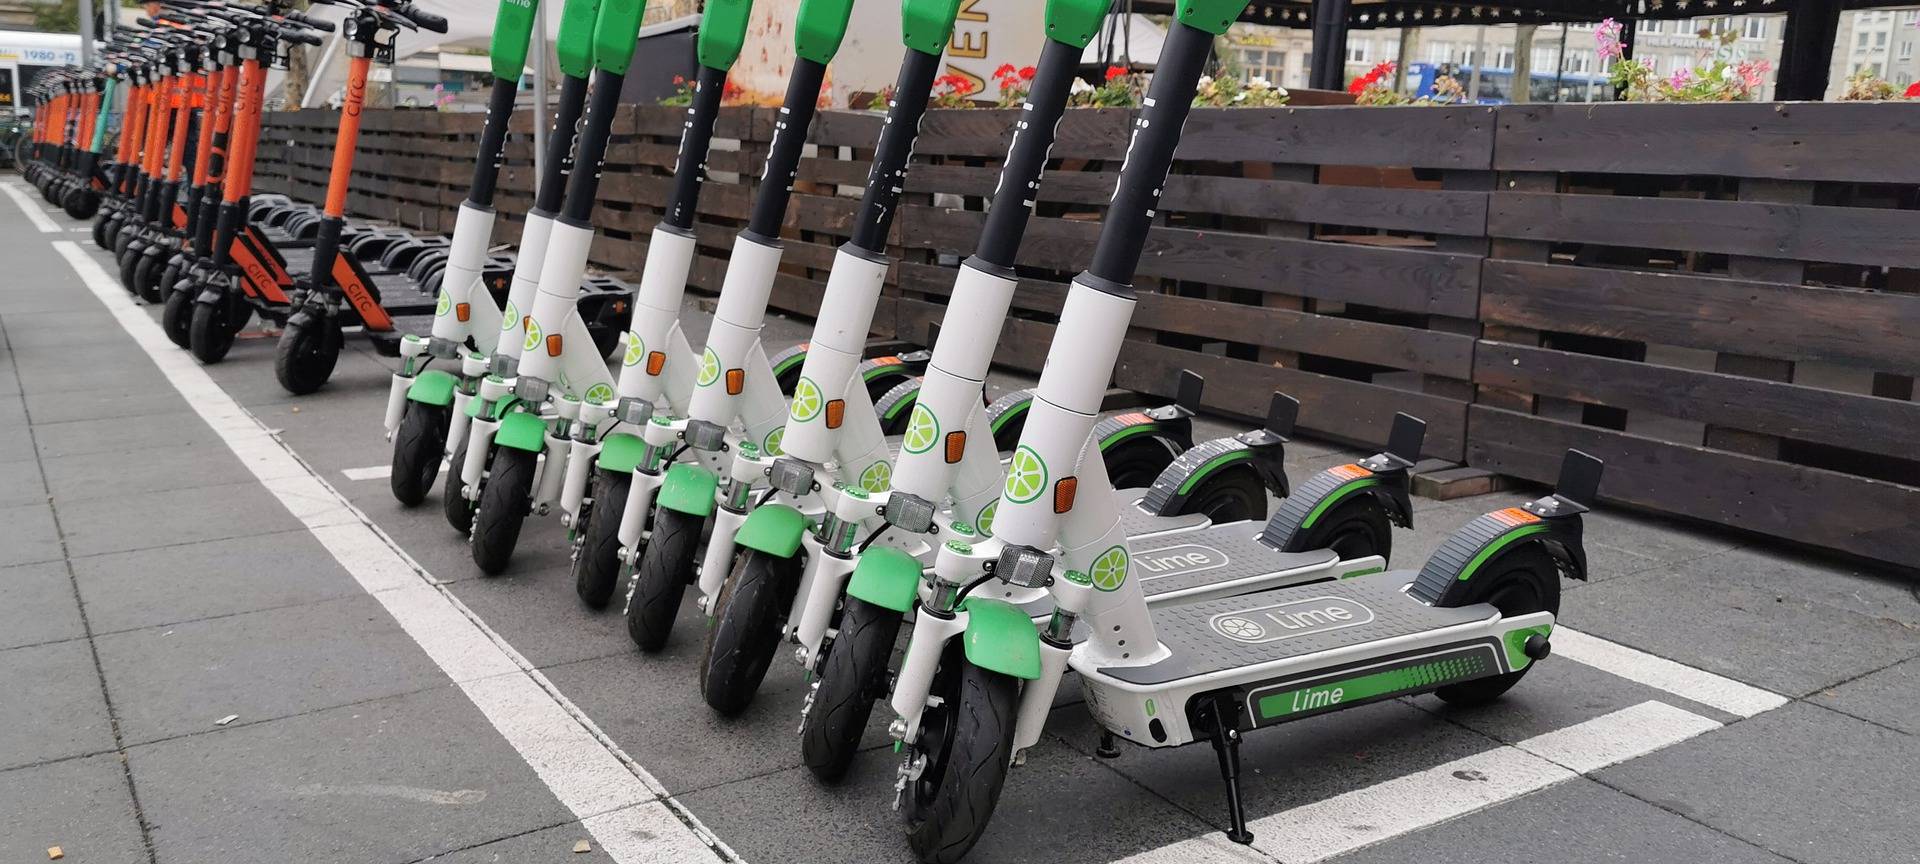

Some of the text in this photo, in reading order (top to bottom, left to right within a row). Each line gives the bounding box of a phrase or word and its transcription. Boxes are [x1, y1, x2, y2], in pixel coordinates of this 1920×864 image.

[348, 78, 365, 117] circ
[248, 263, 272, 289] circ
[348, 282, 373, 312] circ
[1133, 552, 1211, 572] Lime
[1266, 606, 1353, 629] Lime
